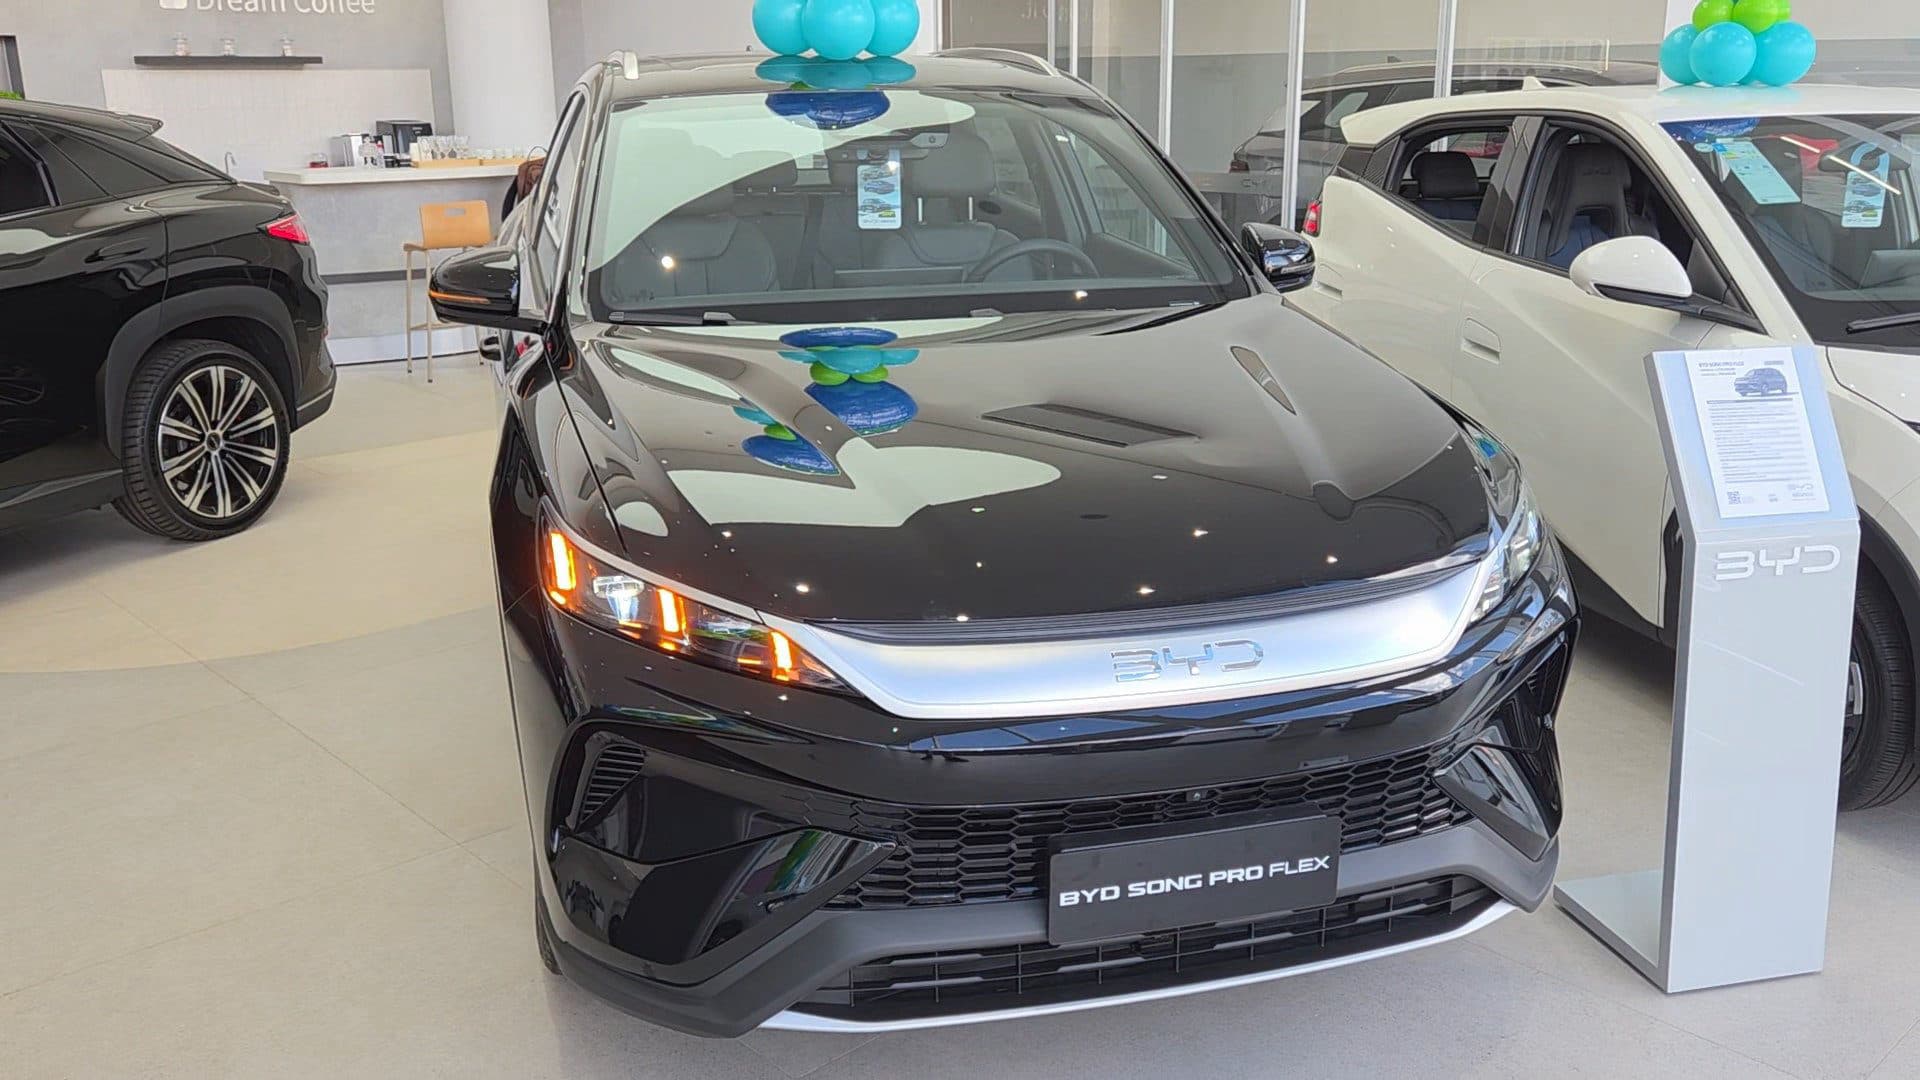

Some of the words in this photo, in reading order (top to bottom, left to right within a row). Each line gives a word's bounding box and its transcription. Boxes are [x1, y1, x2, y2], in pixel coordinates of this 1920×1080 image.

[1715, 544, 1841, 580] BYD
[1110, 639, 1264, 683] BYD
[1059, 886, 1121, 907] BYD
[1127, 874, 1203, 898] SONG
[1208, 865, 1264, 887] PRO
[1268, 855, 1331, 878] FLEX
